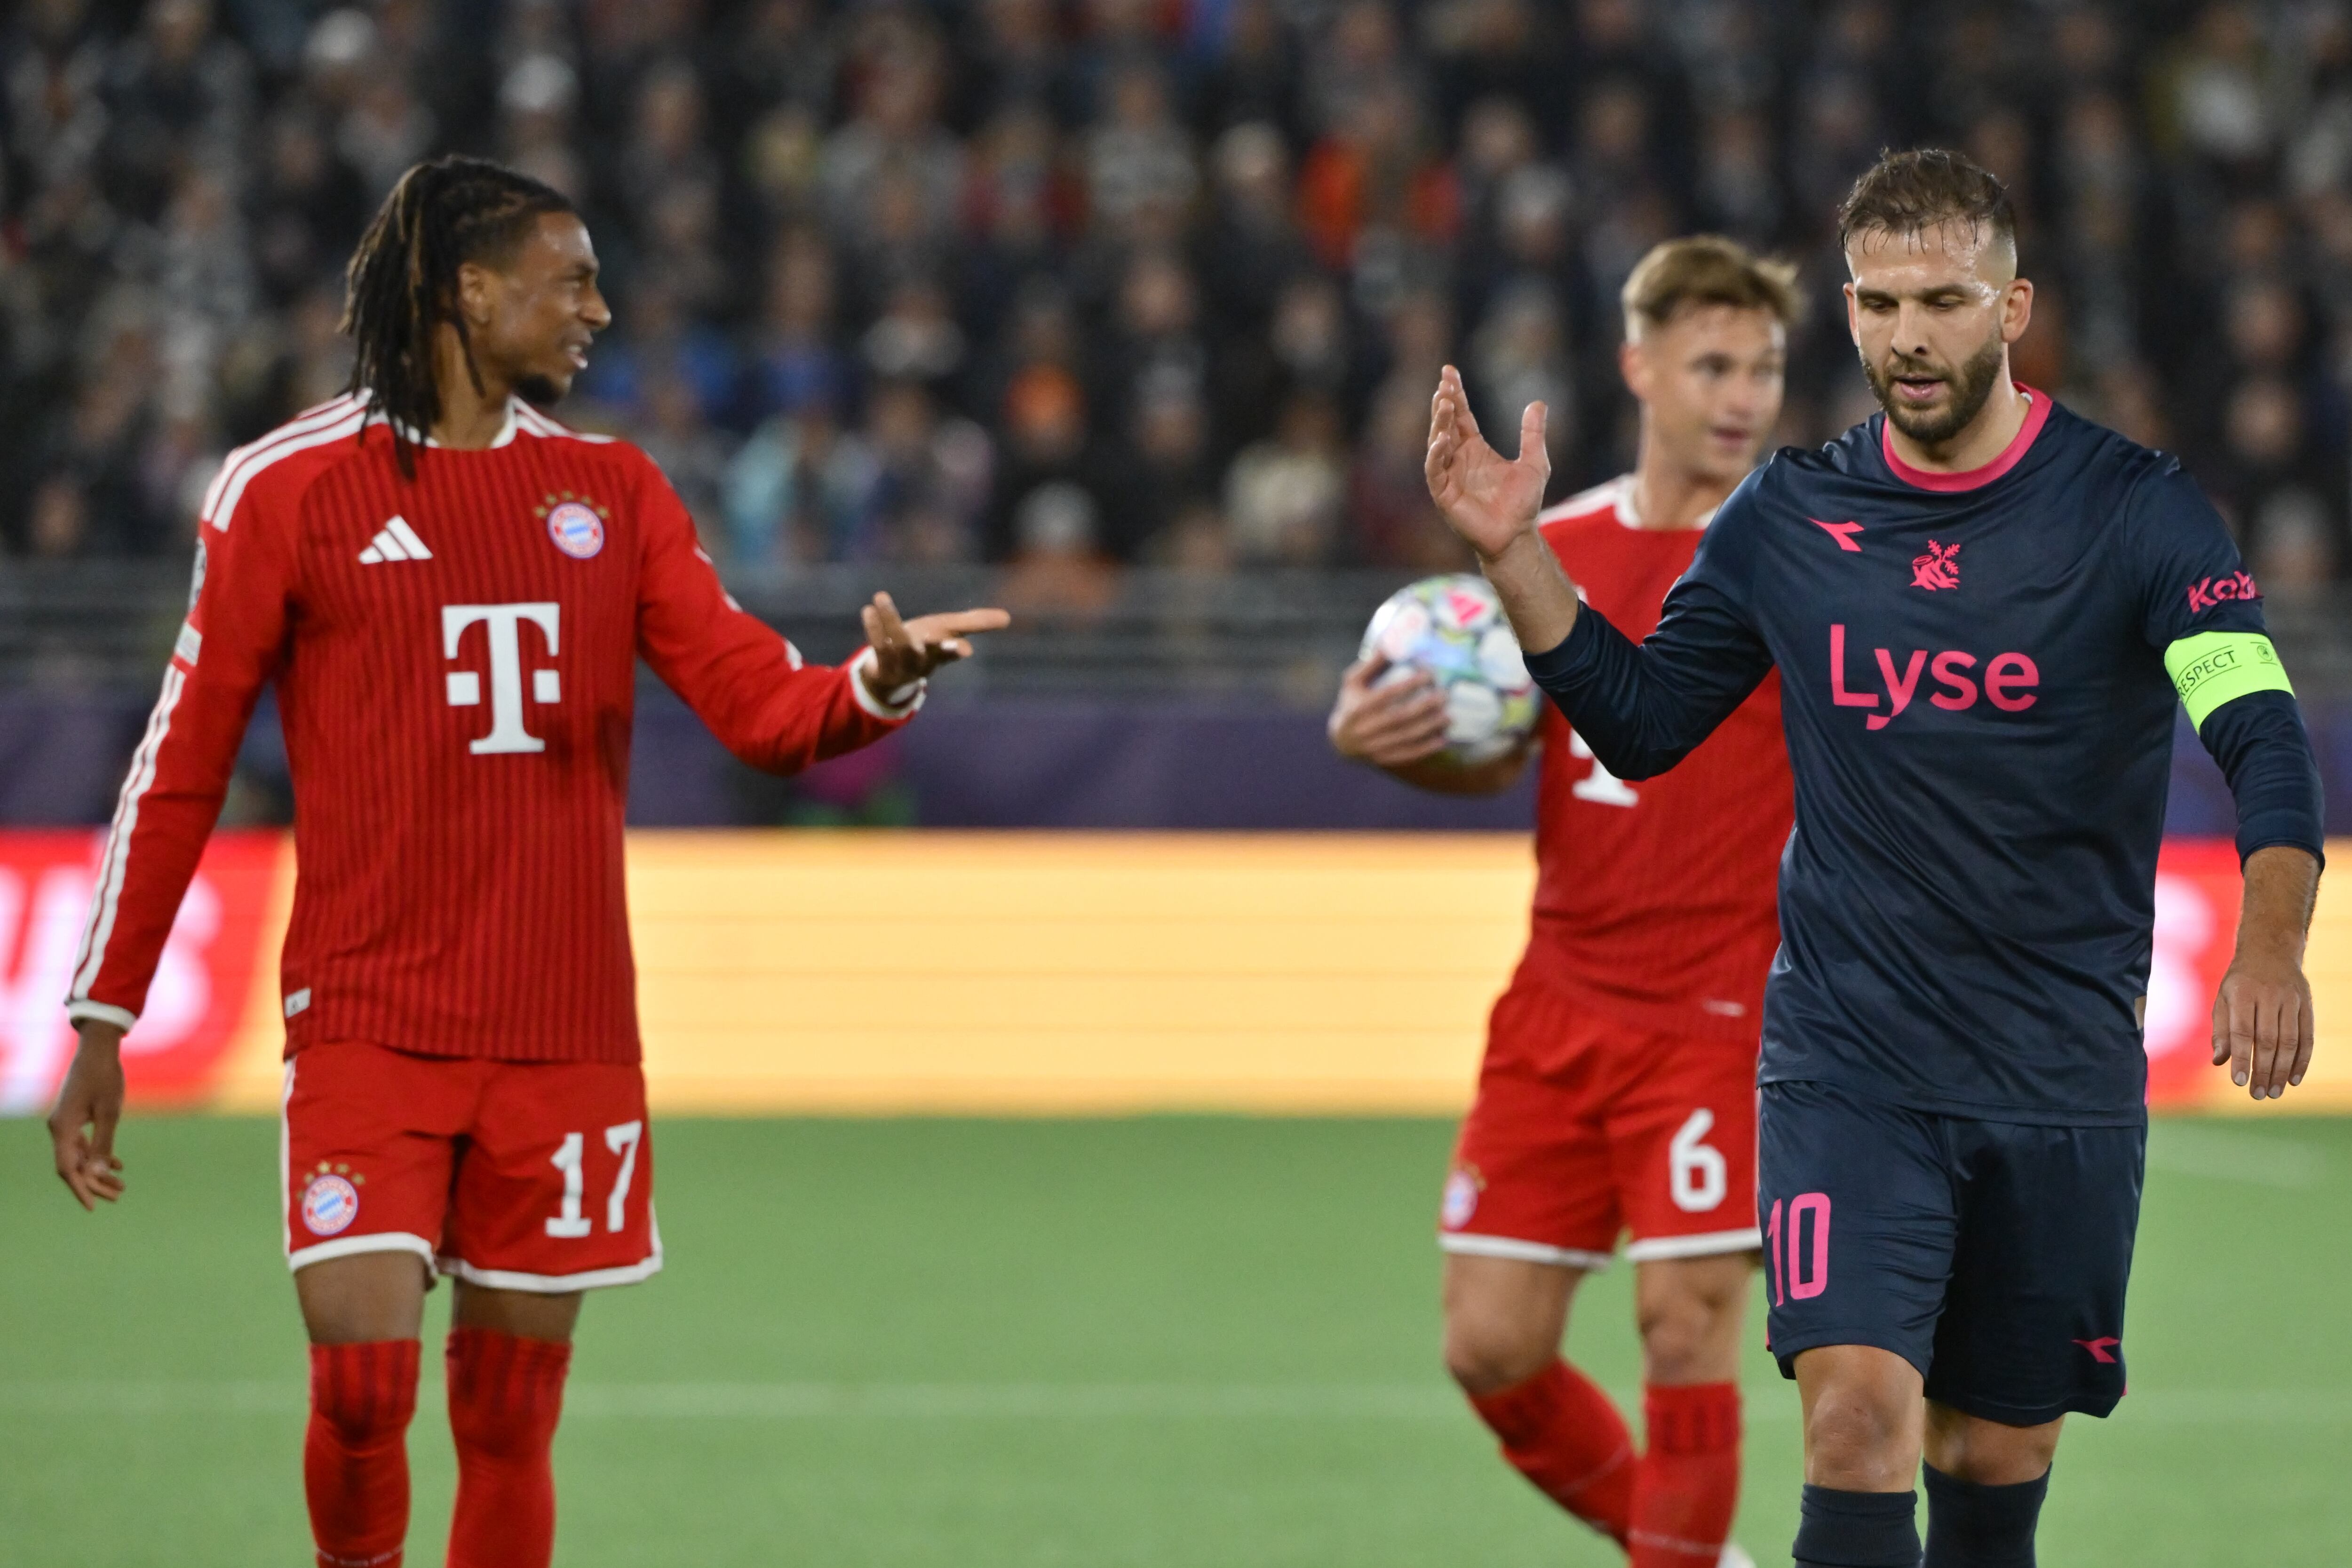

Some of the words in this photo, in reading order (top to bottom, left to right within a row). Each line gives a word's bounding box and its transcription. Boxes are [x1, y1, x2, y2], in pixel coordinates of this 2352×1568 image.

[442, 602, 560, 754] T
[1830, 624, 2039, 730] Lyse
[2177, 650, 2235, 697] RESPECT
[545, 1119, 642, 1237] 17
[1669, 1108, 1726, 1212] 6
[1767, 1192, 1831, 1307] 10
